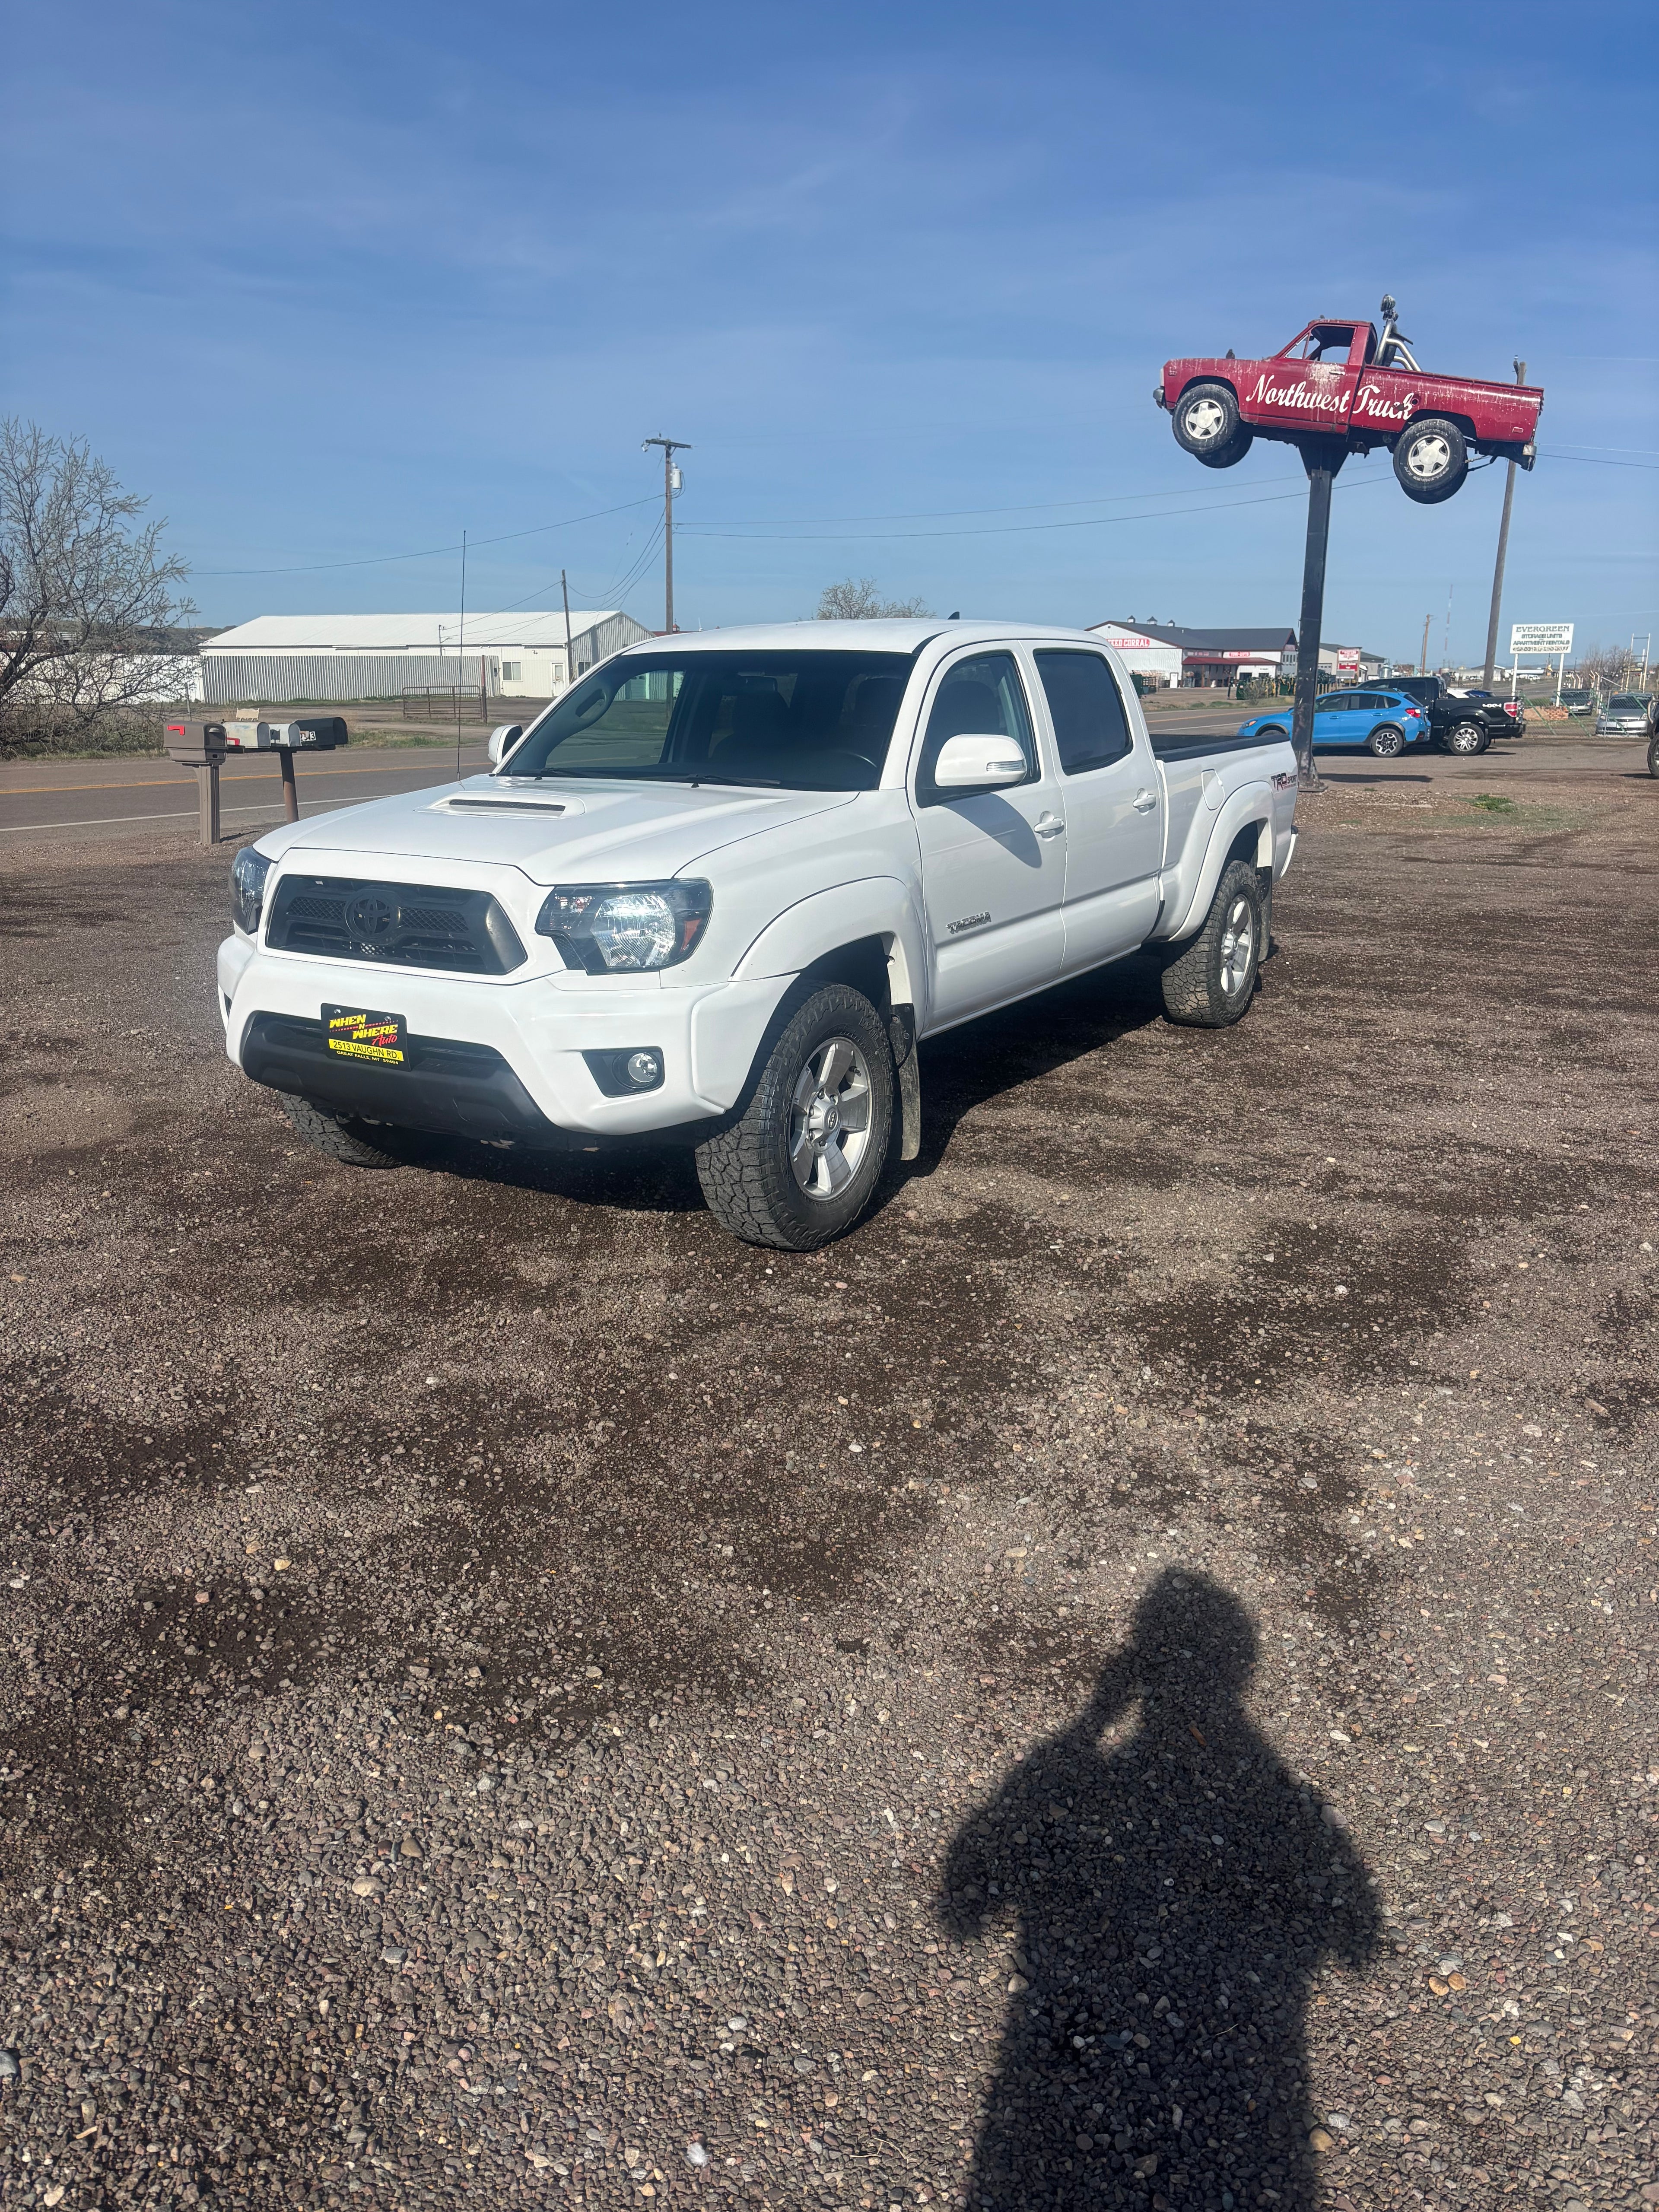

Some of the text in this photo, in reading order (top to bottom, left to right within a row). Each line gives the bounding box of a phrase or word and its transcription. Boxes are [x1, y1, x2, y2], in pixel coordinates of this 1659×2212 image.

[1246, 374, 1414, 420] Northwest Truck
[1271, 772, 1287, 791] TRD
[945, 912, 992, 934] TACOMA
[329, 1014, 366, 1028] WHEN
[353, 1024, 398, 1039] WHERE
[372, 1034, 397, 1047] Auto
[333, 1041, 400, 1059] 2513 VAUGHN RD.
